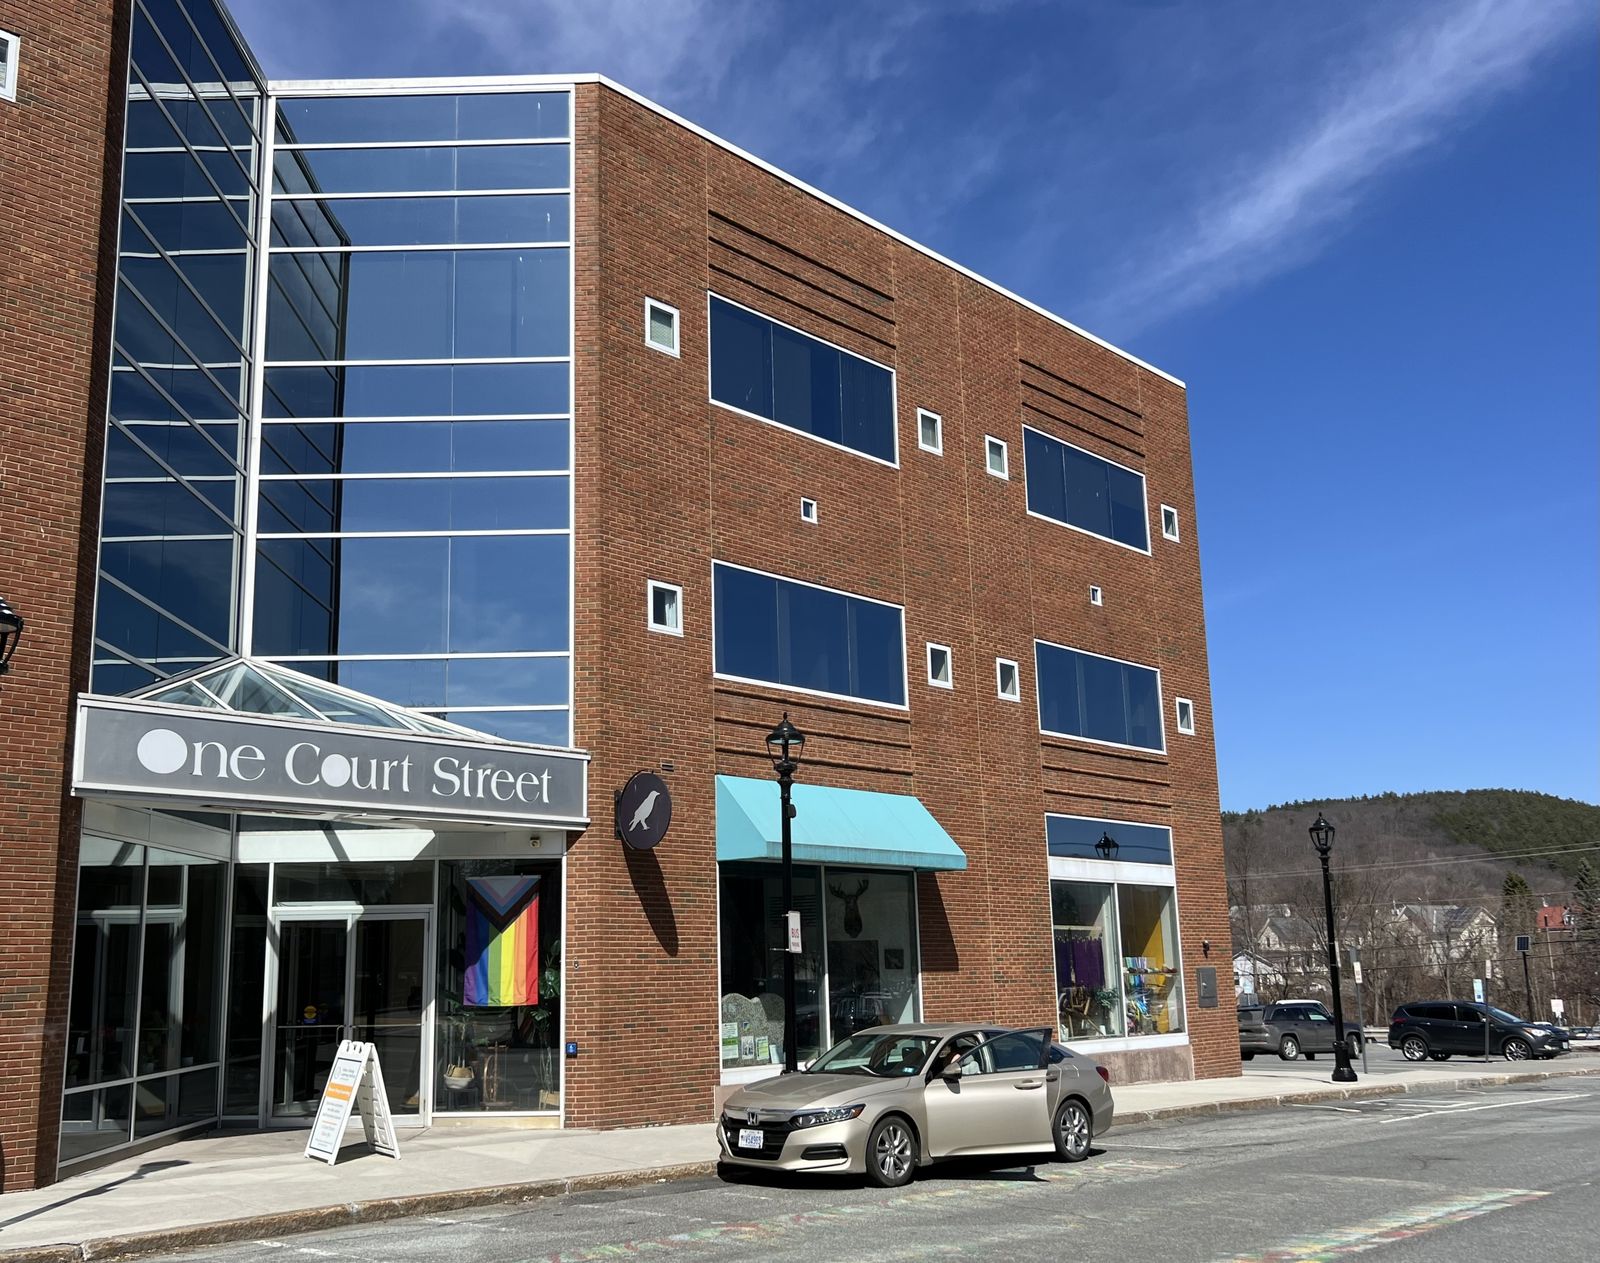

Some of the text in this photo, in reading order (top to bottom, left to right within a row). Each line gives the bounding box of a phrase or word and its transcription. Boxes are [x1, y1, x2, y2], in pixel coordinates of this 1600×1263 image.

[136, 728, 552, 803] One Court Street
